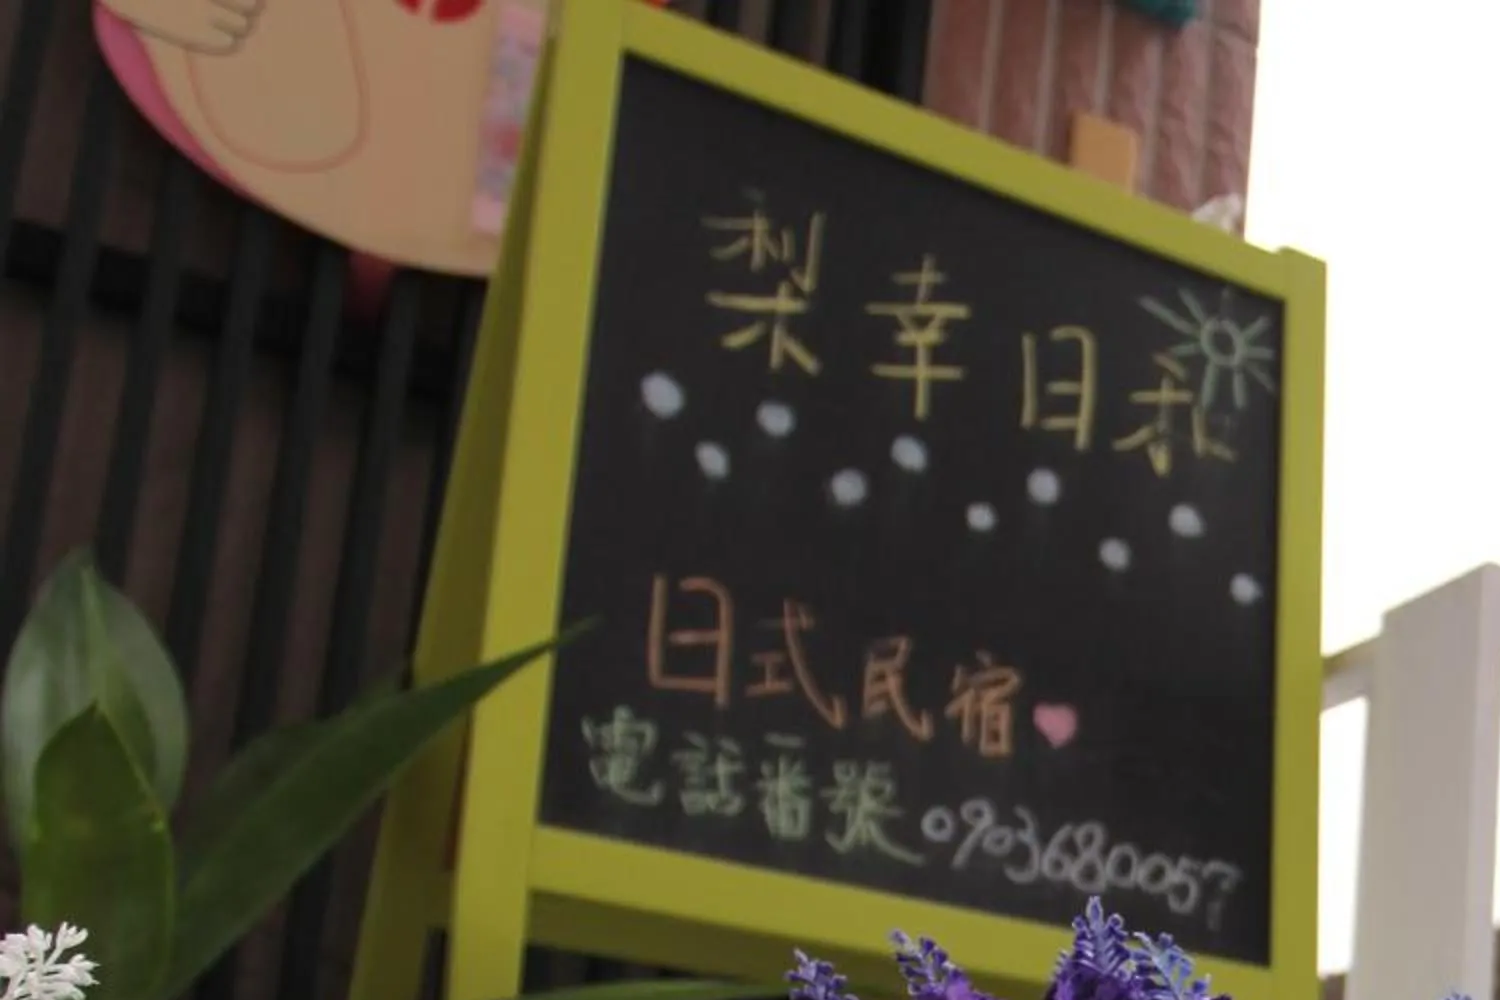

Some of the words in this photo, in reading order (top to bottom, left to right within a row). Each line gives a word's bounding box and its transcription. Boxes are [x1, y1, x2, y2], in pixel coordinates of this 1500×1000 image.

[646, 573, 1024, 758] 日式民宿
[920, 797, 1243, 930] 0903680057
